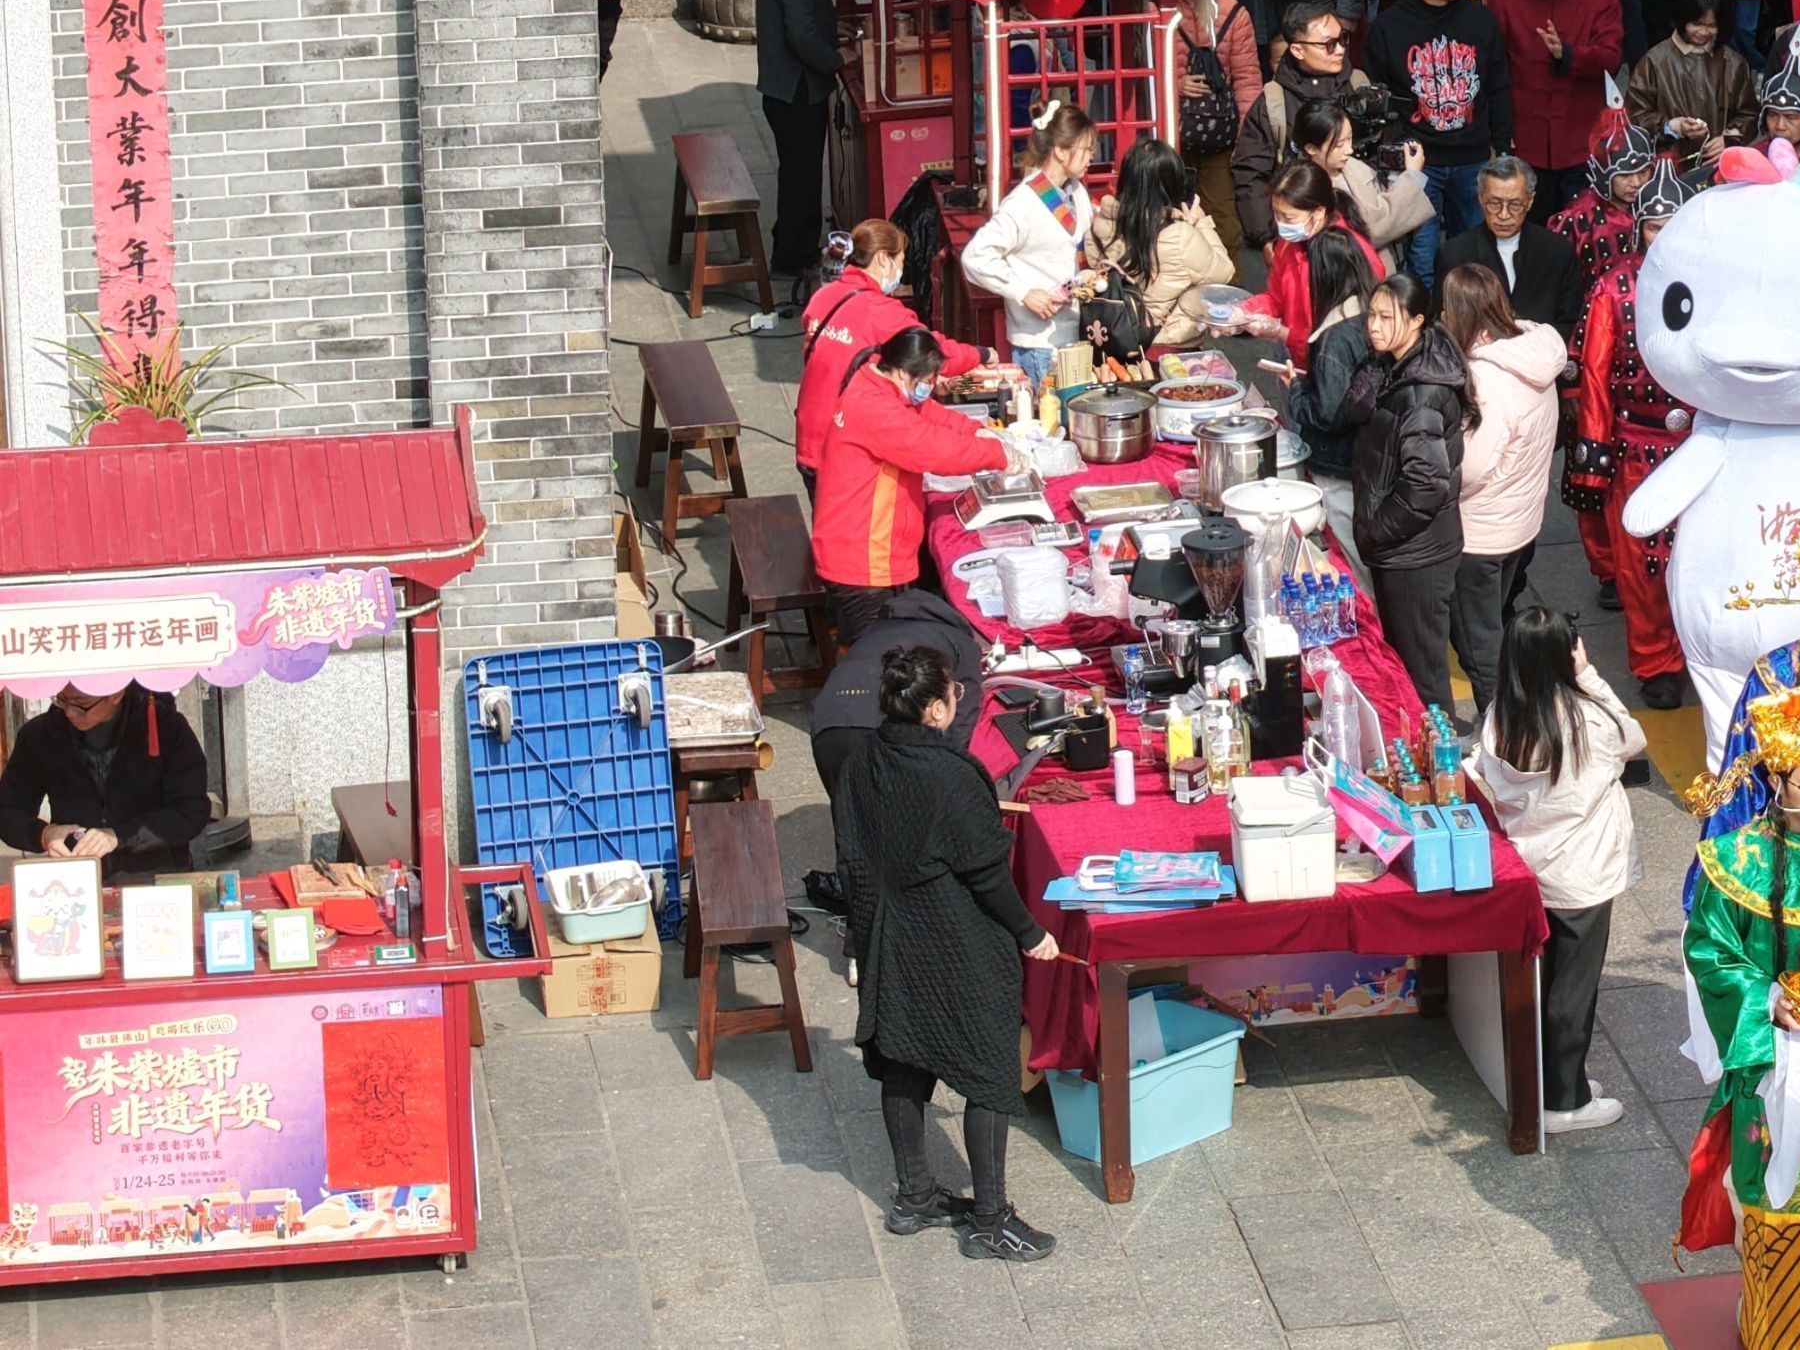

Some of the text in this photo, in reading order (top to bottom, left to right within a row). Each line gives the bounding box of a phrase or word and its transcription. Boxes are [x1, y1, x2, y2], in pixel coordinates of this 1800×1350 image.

[266, 574, 364, 616] 朱紫墟市
[1, 615, 219, 657] 山笑开眉开运年画
[273, 599, 386, 644] 非遗年货
[90, 1044, 241, 1097] 朱紫墟市
[107, 1082, 283, 1141] 非遗年货
[138, 1150, 223, 1165] 千万福利等你来
[122, 1173, 175, 1189] 1/24-25
